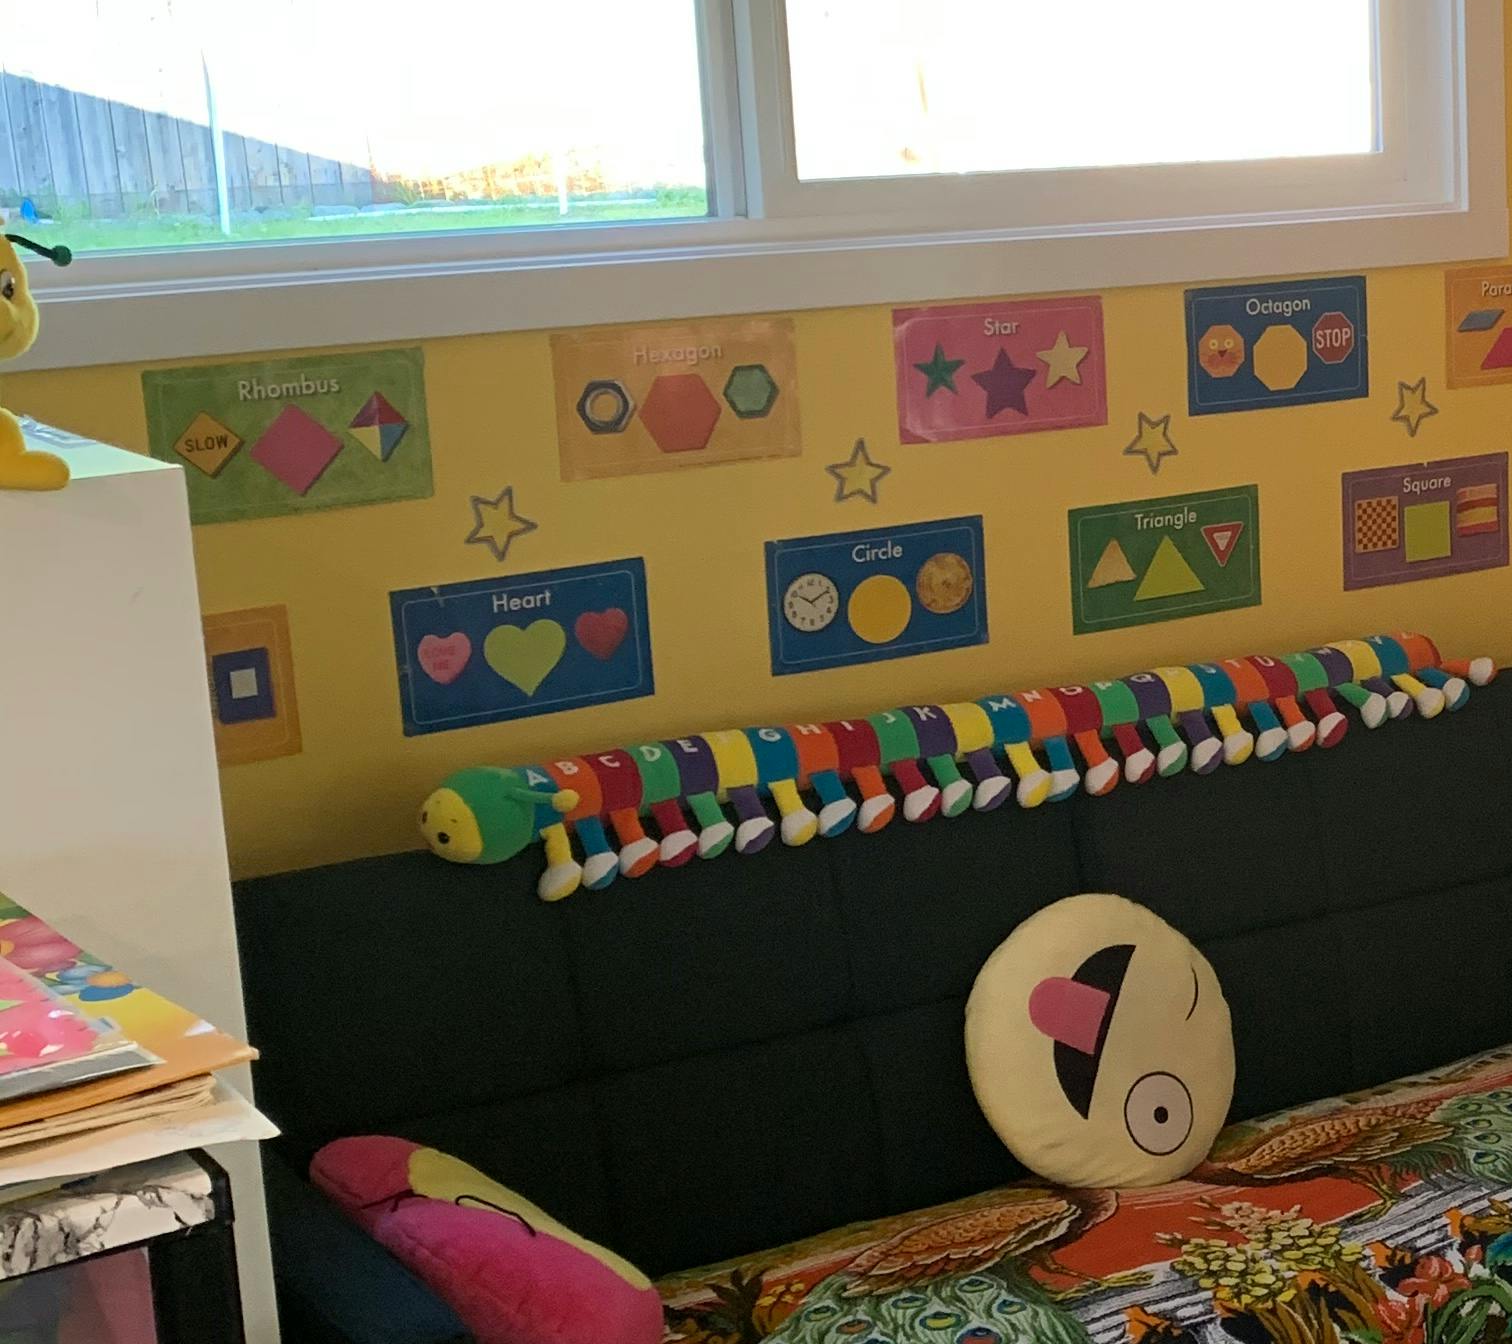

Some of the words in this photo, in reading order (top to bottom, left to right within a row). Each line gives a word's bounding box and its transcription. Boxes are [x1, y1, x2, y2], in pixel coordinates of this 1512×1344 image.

[1246, 298, 1311, 317] Octagon
[984, 318, 1020, 336] Star
[1316, 328, 1351, 349] STOP
[632, 344, 722, 365] Hexagon
[237, 374, 341, 401] Rhombus
[184, 435, 229, 453] SLOW
[1403, 476, 1452, 495] Square
[1134, 506, 1197, 531] Triangle
[852, 539, 904, 563] Circle
[493, 591, 551, 613] Heart
[526, 769, 548, 786] A
[554, 761, 579, 775] B
[599, 755, 621, 768] C
[639, 745, 661, 761] D
[677, 739, 698, 753] E
[758, 728, 782, 742] G
[798, 724, 822, 735] H
[881, 712, 896, 724] J
[913, 706, 937, 721] K
[989, 697, 1017, 712] M
[1021, 690, 1042, 703] N
